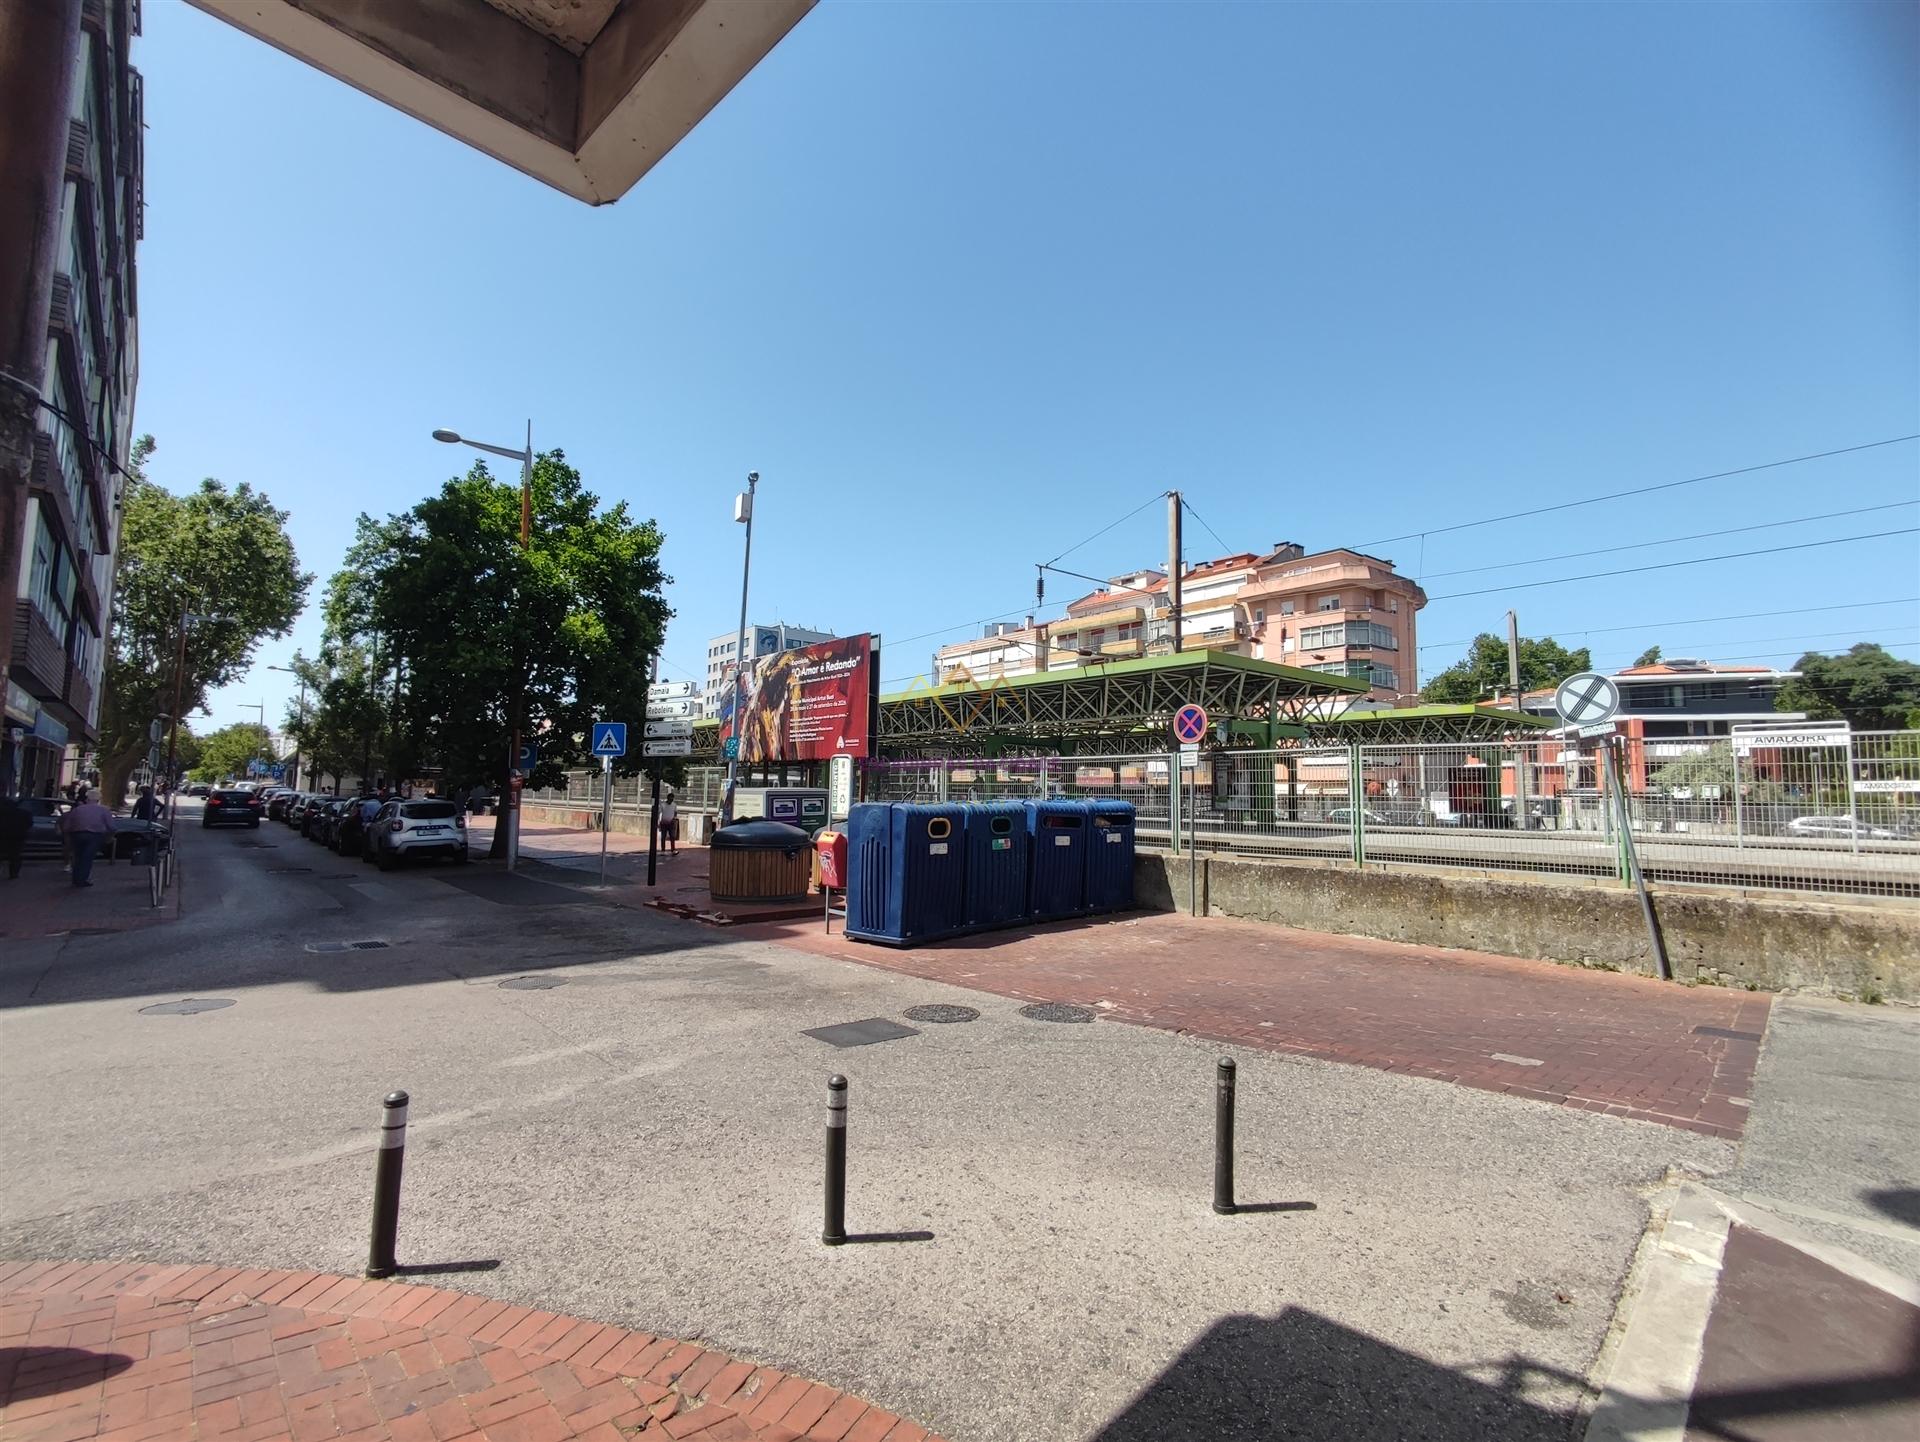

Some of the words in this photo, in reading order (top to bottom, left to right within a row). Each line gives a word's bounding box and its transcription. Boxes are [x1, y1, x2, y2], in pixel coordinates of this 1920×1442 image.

[800, 666, 818, 676] Amor
[650, 687, 669, 695] Damaia
[647, 705, 673, 715] Reboleira
[1754, 735, 1827, 744] AMADORA
